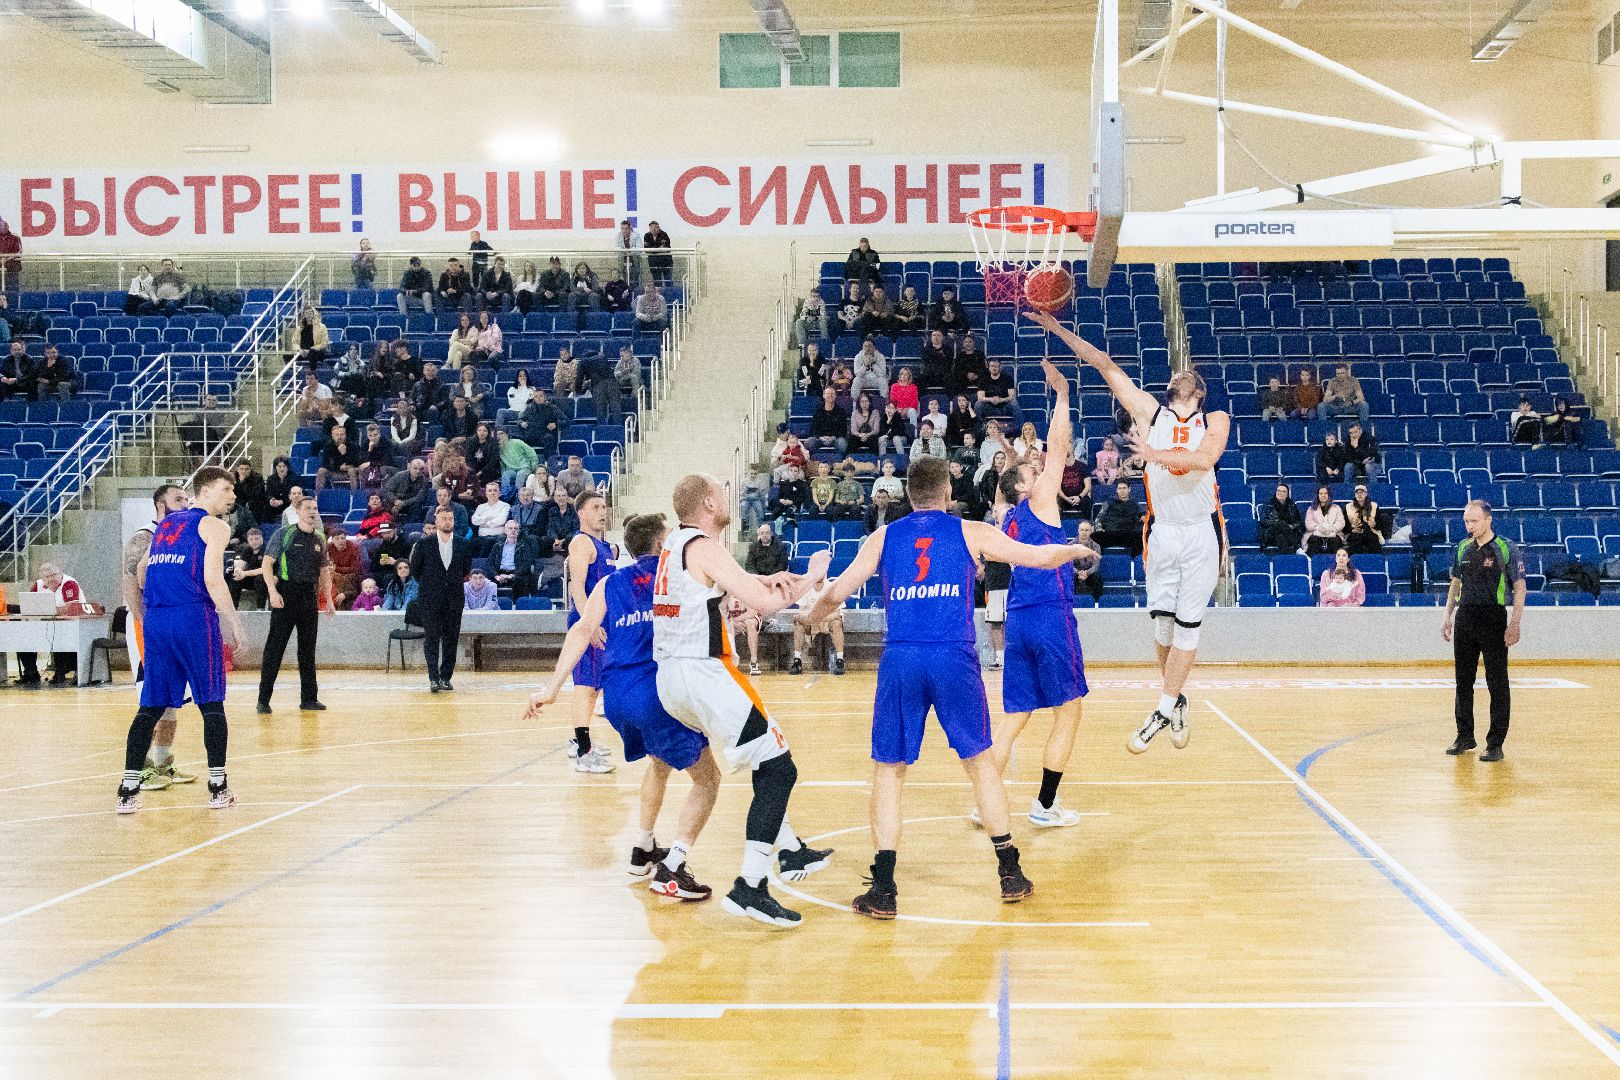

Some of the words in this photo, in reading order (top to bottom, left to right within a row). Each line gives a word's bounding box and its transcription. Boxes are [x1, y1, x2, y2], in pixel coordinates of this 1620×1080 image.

[20, 173, 363, 237] БЫСТРЕЕ!
[398, 168, 638, 233] ВЫШЕ!
[672, 163, 1045, 227] СИЛЬНЕЕ!
[1172, 425, 1190, 444] 15
[913, 537, 934, 582] 3
